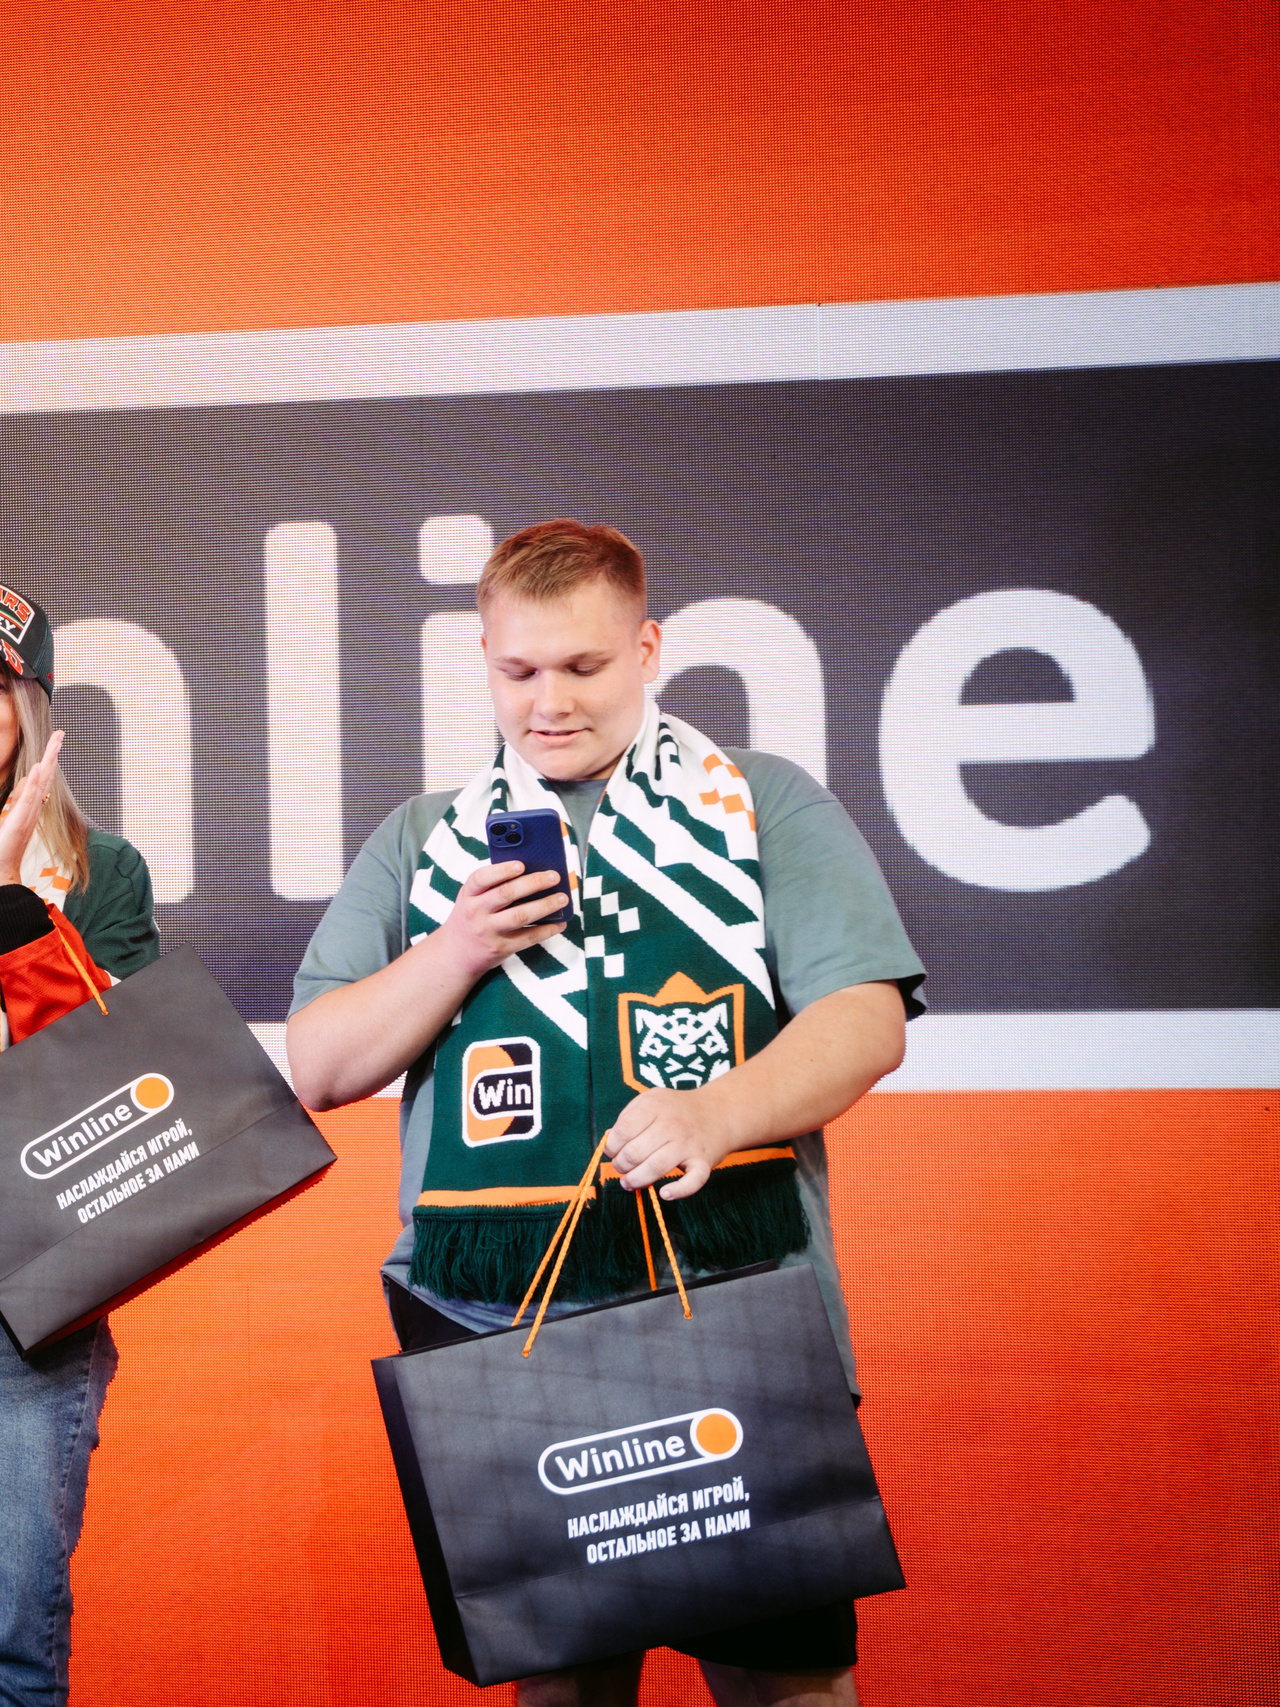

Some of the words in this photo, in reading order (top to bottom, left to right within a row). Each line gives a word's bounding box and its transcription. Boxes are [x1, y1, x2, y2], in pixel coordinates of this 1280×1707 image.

[477, 1078, 532, 1110] Win
[32, 1104, 133, 1168] Winline
[56, 1145, 148, 1210] НАСЛАЖДАЙСЯ
[147, 1118, 193, 1156] ИГРОЙ,
[77, 1174, 147, 1224] ОСТАЛЬНОЕ
[145, 1163, 164, 1184] ЗА
[163, 1141, 200, 1173] НАМИ
[555, 1434, 687, 1482] Winline
[567, 1493, 689, 1539] НАСЛАЖДАЙСЯ
[692, 1476, 751, 1511] ИГРОЙ,
[586, 1526, 677, 1565] ОСТАЛЬНОЕ
[680, 1520, 702, 1544] ЗА
[705, 1508, 752, 1538] НАМИ
